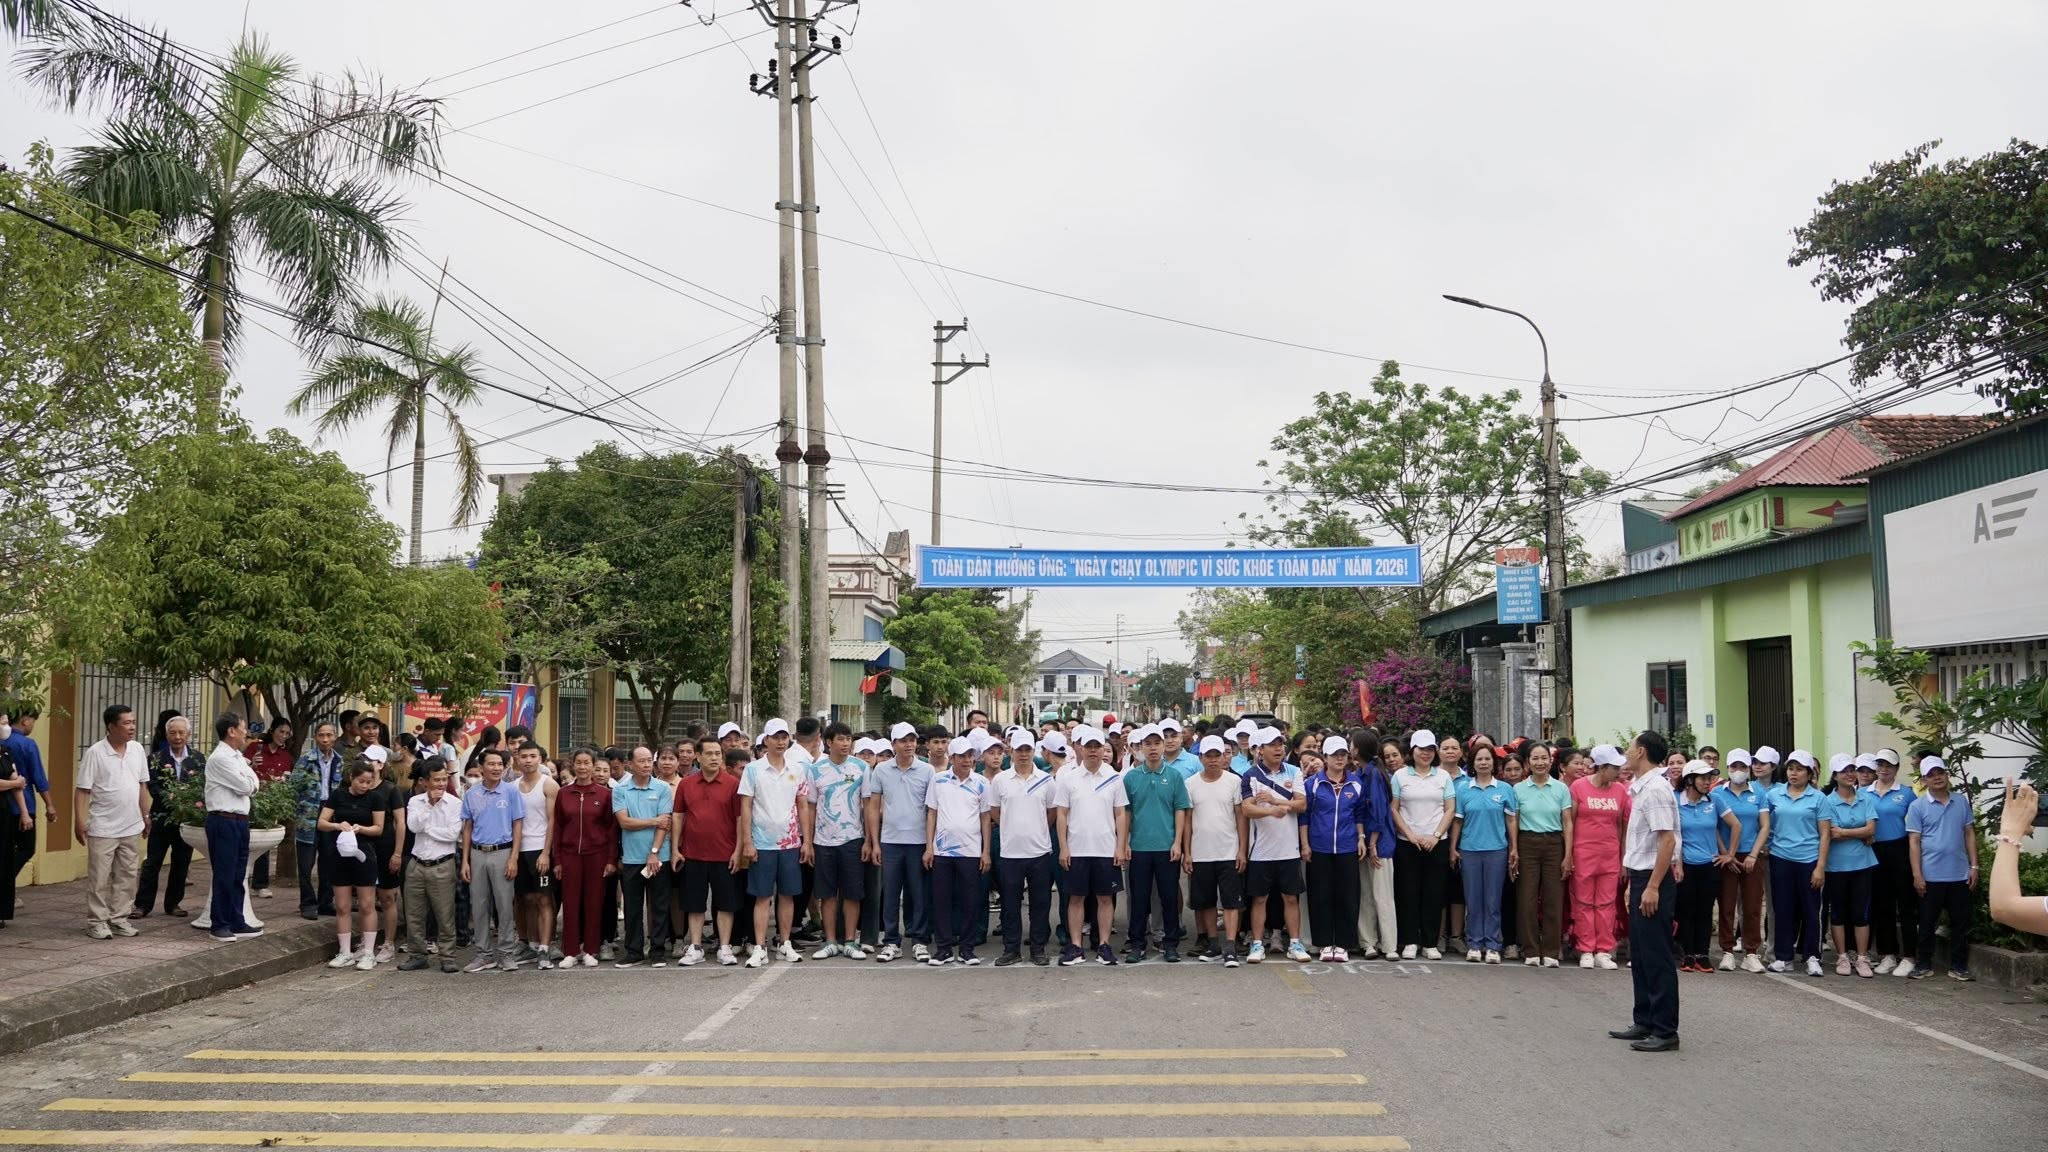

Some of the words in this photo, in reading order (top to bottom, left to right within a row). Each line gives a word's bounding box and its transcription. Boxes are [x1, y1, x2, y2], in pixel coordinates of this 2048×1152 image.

[1712, 519, 1729, 541] 2011
[932, 555, 963, 577] TOÀN
[966, 555, 992, 577] DÂN
[995, 552, 1035, 577] HƯỞNG
[1039, 554, 1067, 577] ỨNG:
[1111, 558, 1141, 580] CHẠY
[1145, 558, 1198, 577] OLYMPIC
[1201, 555, 1213, 577] VÌ
[1216, 554, 1240, 577] SỨC
[1243, 552, 1275, 577] KHỎE
[1278, 555, 1309, 577] TOÀN
[1344, 555, 1372, 576] NĂM
[1375, 558, 1408, 576] 2026!
[539, 875, 549, 887] 13
